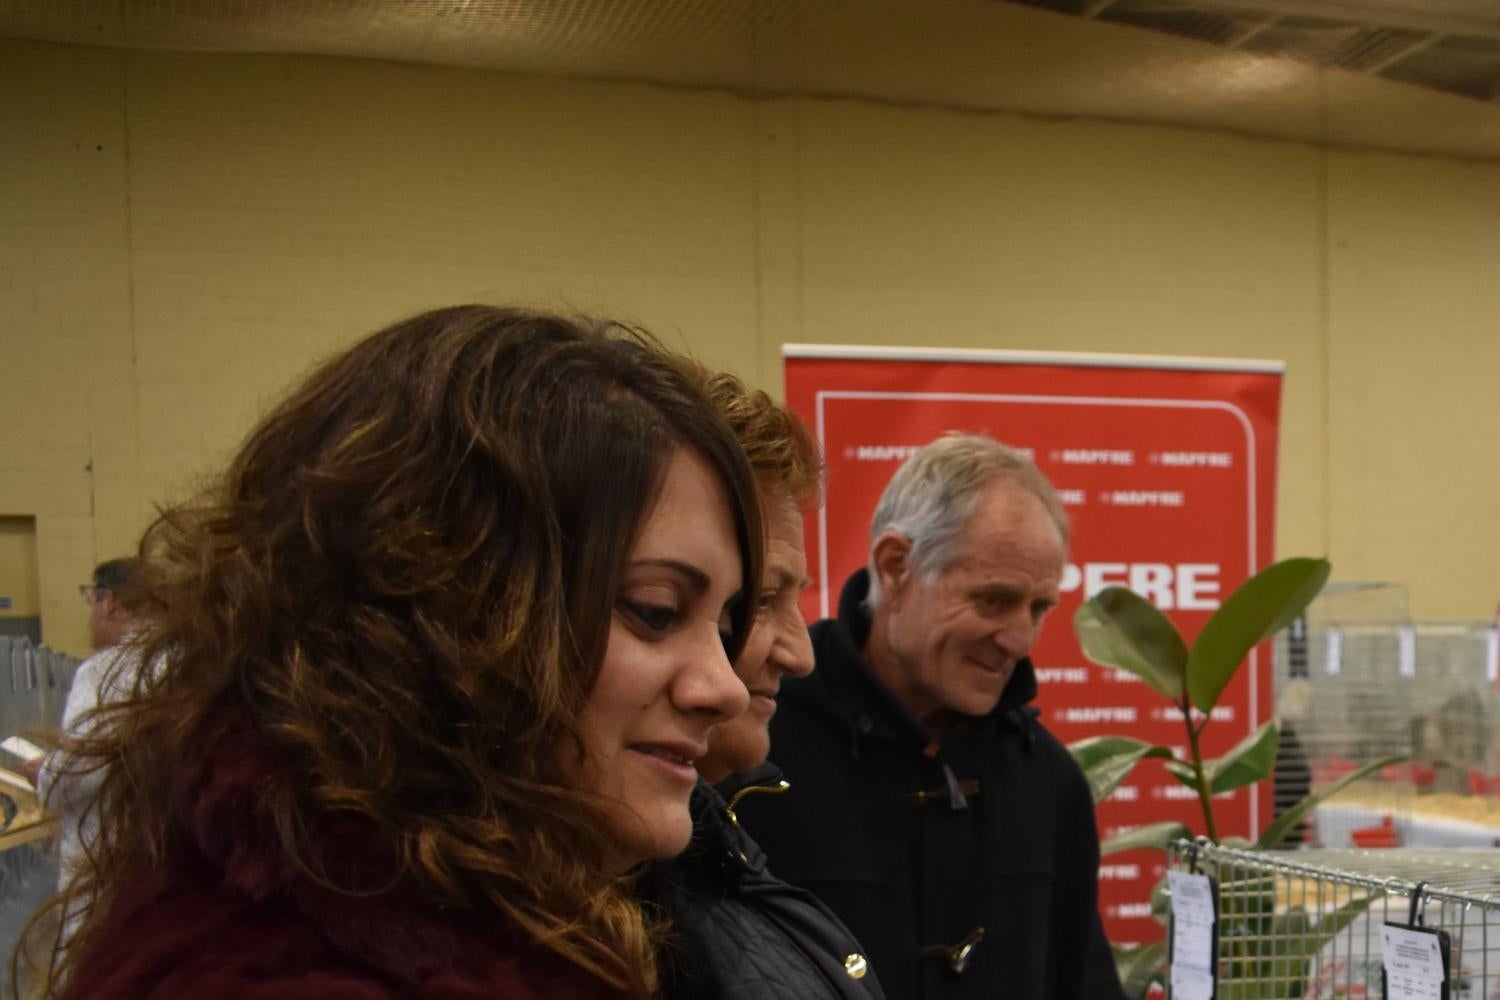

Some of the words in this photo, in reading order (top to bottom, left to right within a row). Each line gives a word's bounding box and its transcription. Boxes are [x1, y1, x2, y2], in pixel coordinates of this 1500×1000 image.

[1062, 449, 1134, 465] MAPFRE
[1162, 452, 1232, 467] MAPFRE
[1112, 491, 1183, 506] MAPFRE
